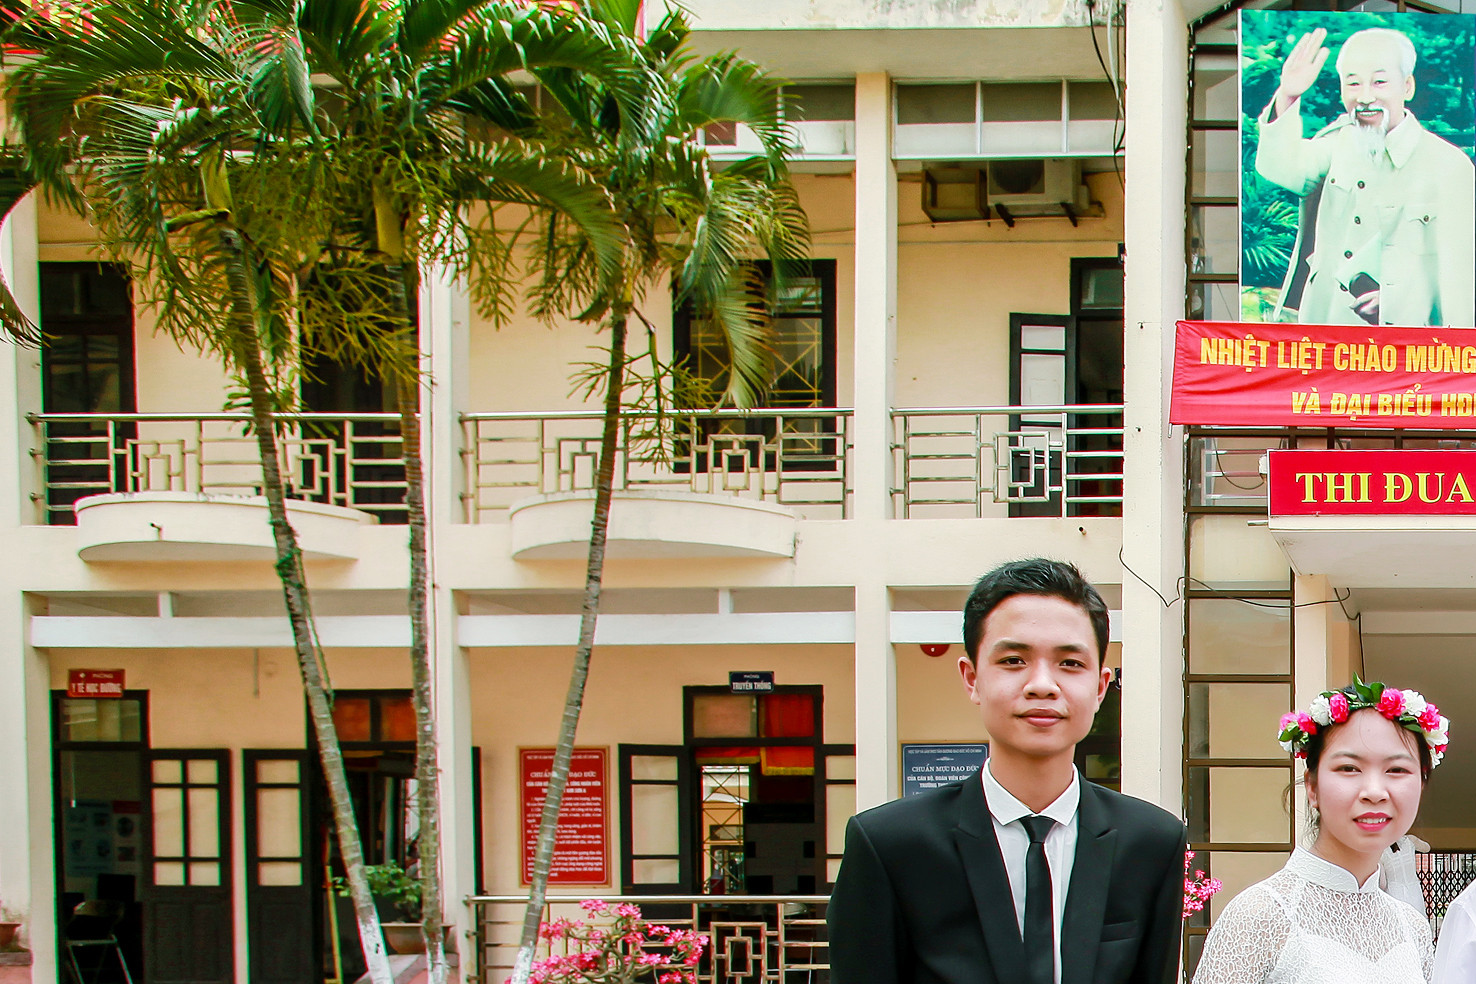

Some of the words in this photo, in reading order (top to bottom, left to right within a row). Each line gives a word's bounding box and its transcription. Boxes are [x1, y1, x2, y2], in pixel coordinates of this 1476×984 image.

[1200, 334, 1270, 373] NHIỆT
[1277, 336, 1326, 375] LIỆT
[1333, 338, 1396, 373] CHÀO
[1405, 337, 1476, 374] MỪNG
[1291, 387, 1321, 415] VÀ
[1330, 392, 1370, 421] ĐẠI
[1378, 383, 1432, 416] BIỂU
[1296, 472, 1373, 504] THI
[1384, 472, 1474, 504] ĐUA
